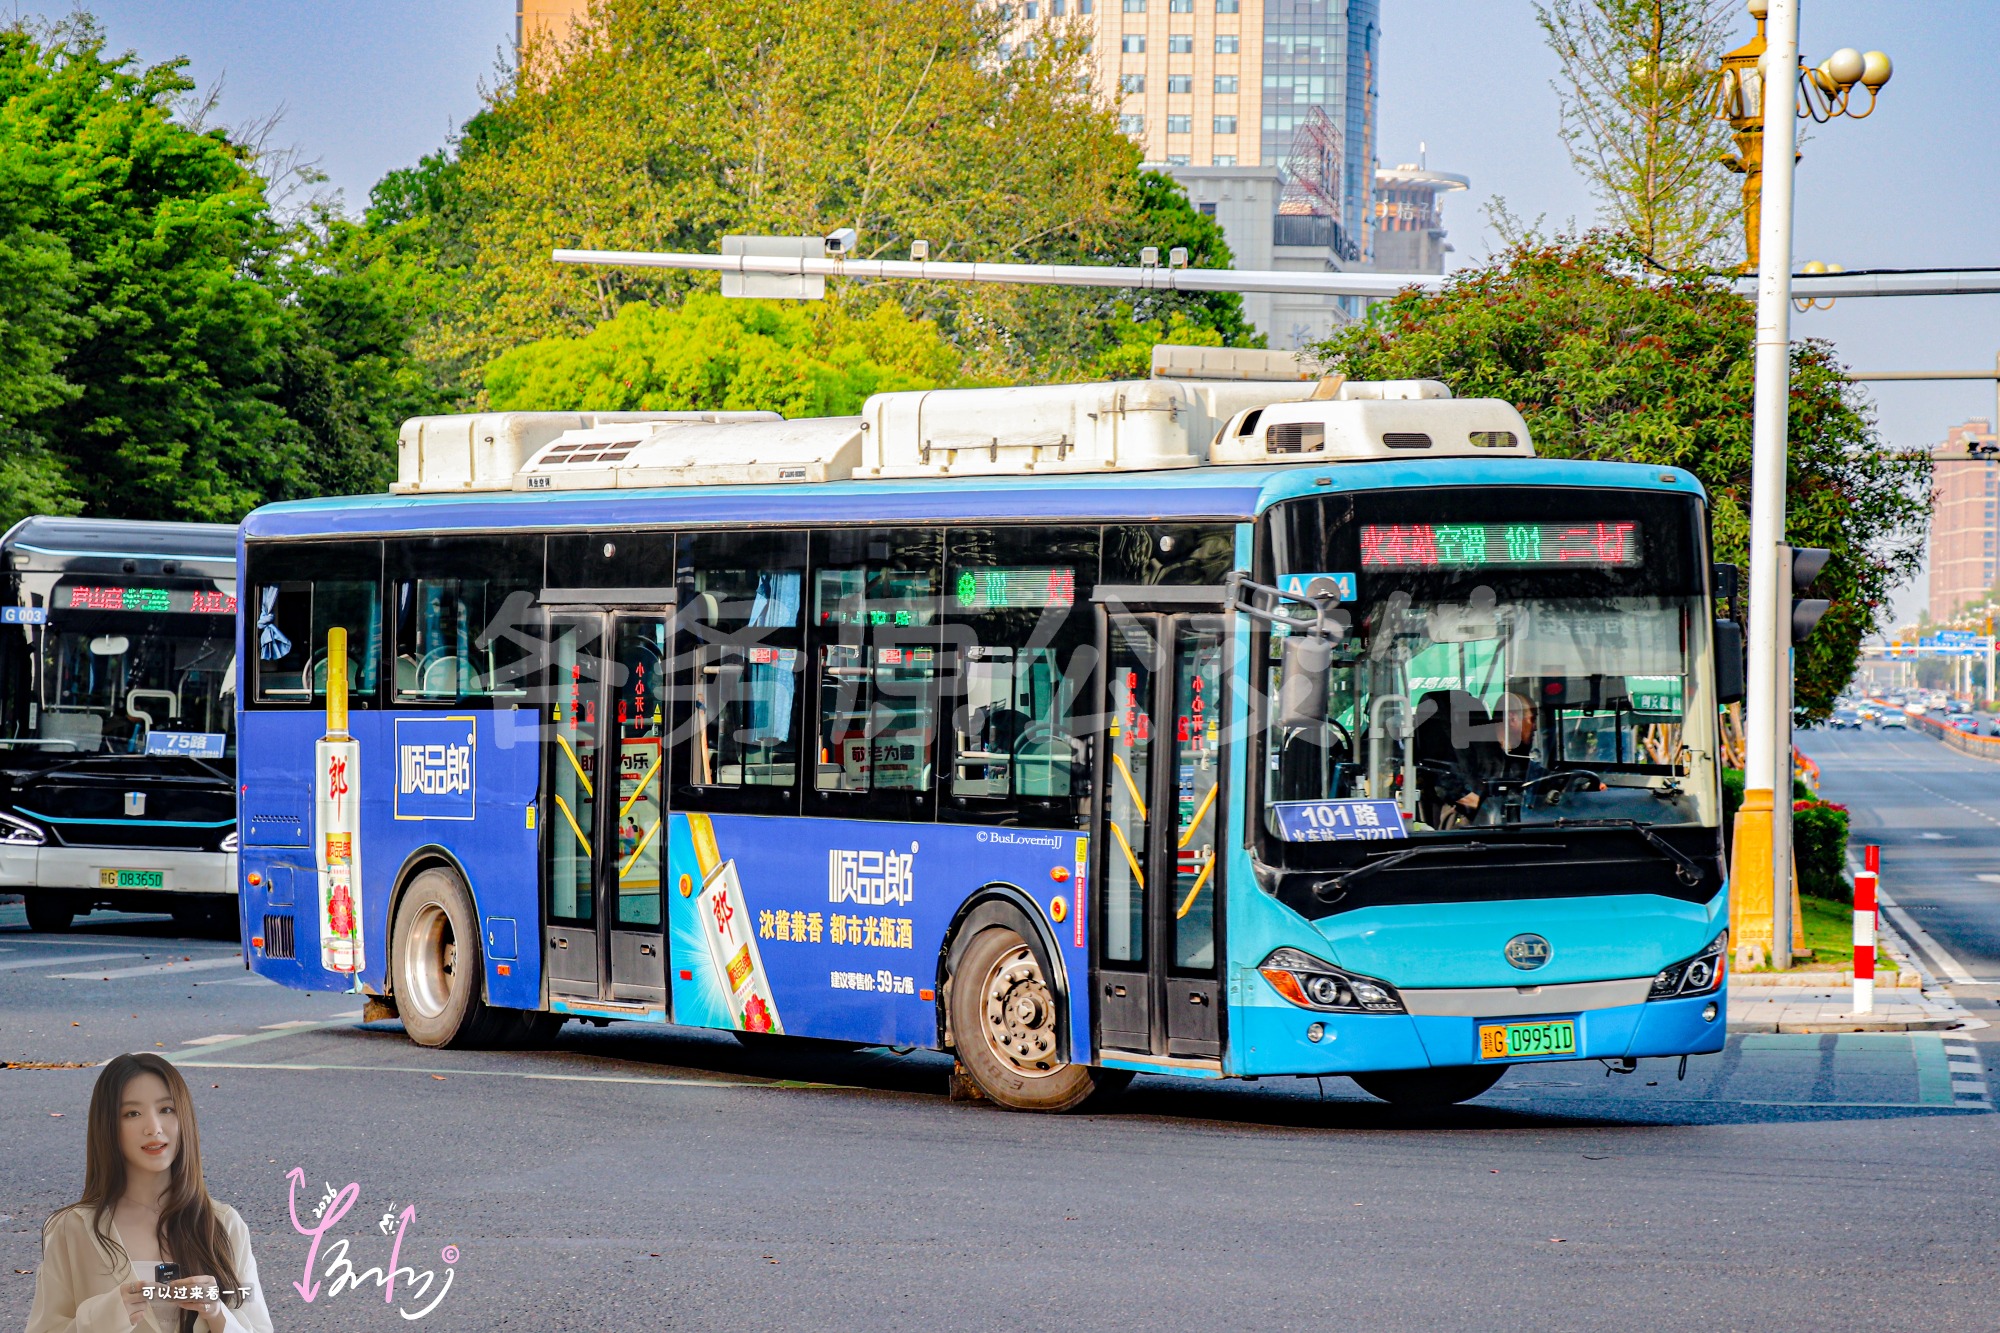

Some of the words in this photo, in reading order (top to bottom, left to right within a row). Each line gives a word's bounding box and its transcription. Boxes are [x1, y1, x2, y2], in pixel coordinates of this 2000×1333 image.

[1505, 526, 1542, 561] 101
[5, 608, 16, 622] G
[18, 609, 42, 623] 003
[166, 734, 207, 749] 75路
[400, 742, 470, 795] 顺品郎
[581, 752, 649, 772] 助为乐
[829, 849, 914, 907] 顺品郎
[759, 909, 824, 943] 浓酱兼香
[830, 913, 913, 949] 都市光瓶酒
[1511, 1026, 1573, 1053] 09951D
